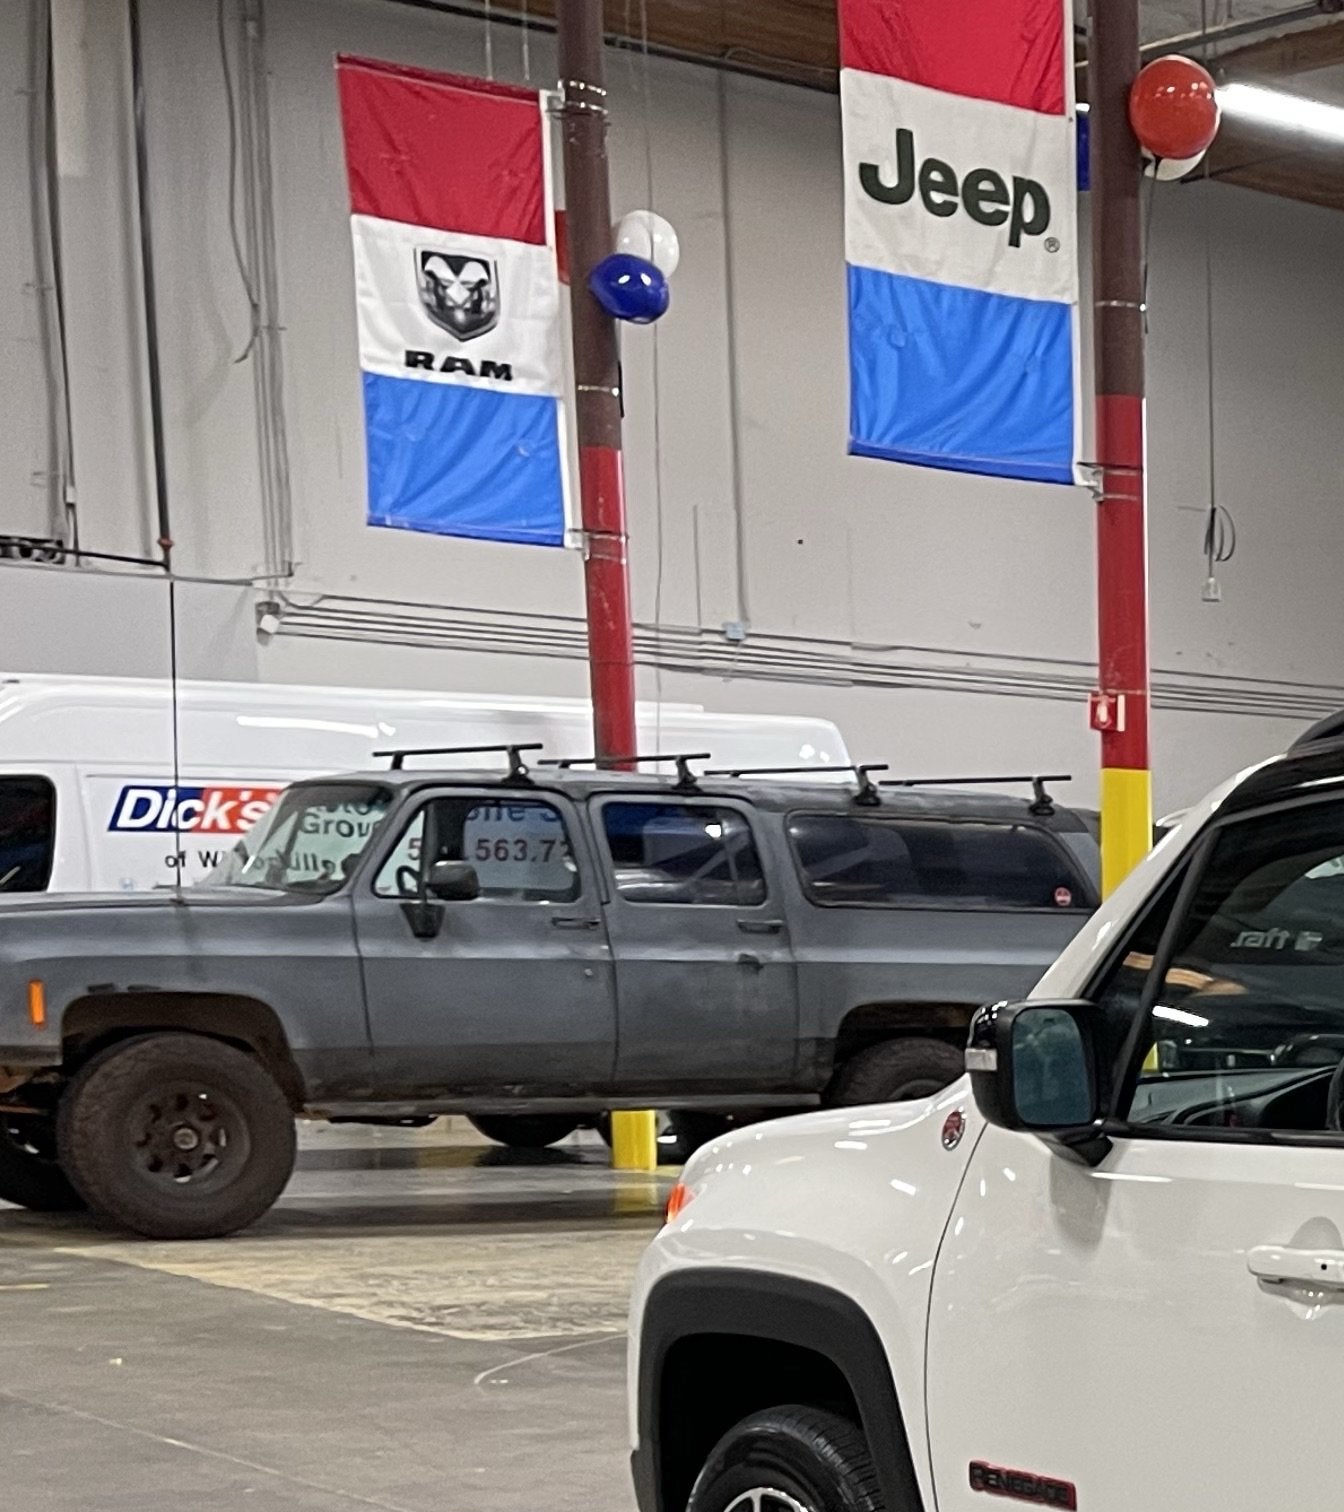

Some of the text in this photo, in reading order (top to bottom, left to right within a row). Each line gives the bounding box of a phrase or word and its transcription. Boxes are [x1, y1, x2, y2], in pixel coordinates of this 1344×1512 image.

[859, 128, 1050, 248] Jeep
[405, 350, 512, 381] RAM
[116, 788, 274, 830] Dick's
[165, 851, 186, 868] of
